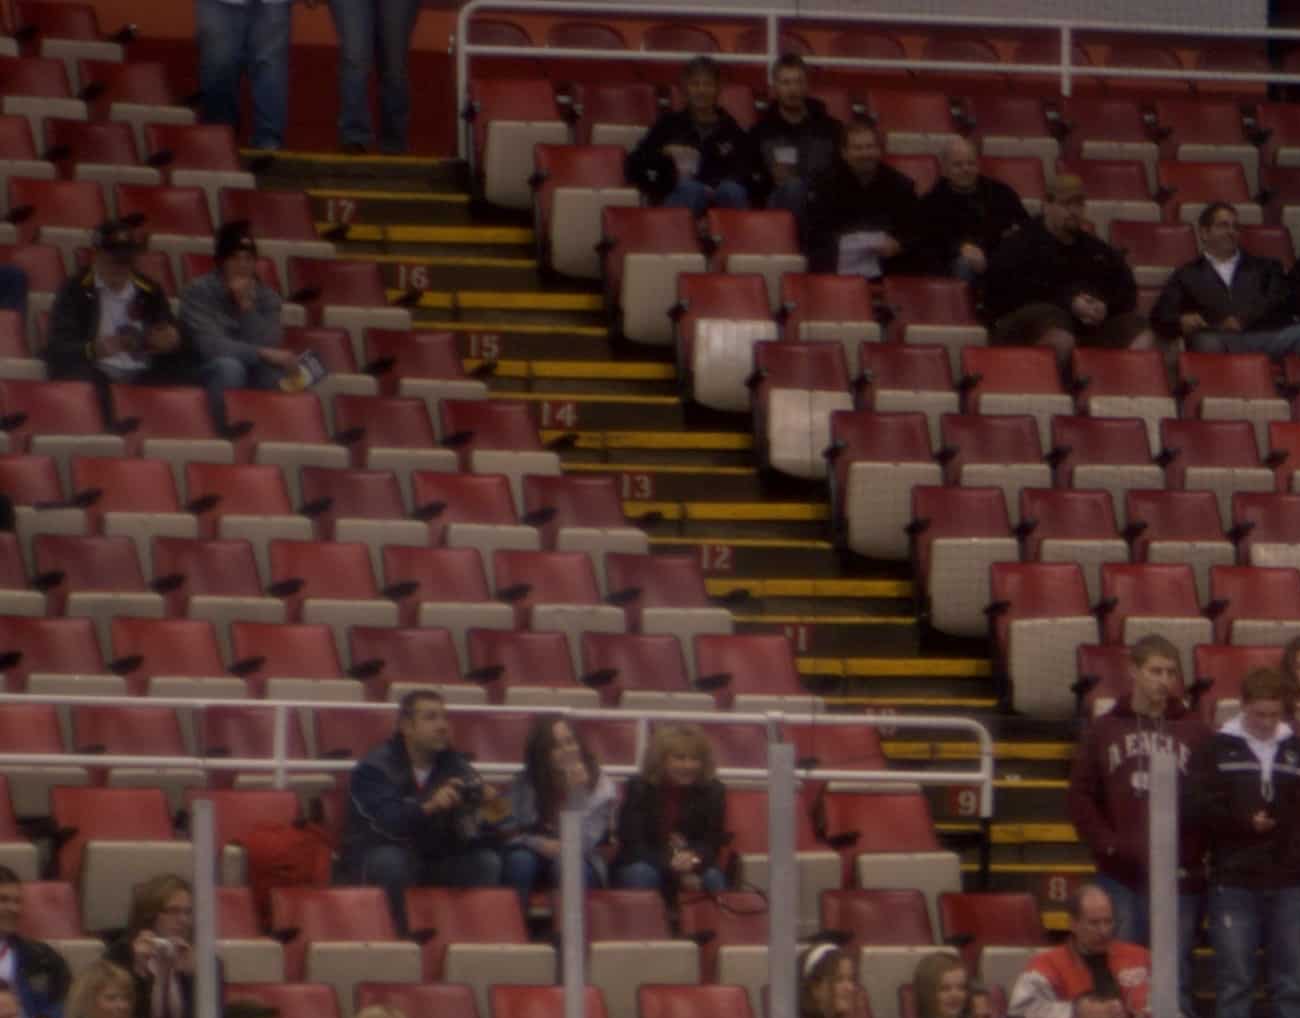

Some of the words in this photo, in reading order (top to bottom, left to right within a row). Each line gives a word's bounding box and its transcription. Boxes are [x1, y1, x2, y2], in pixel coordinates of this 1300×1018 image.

[326, 200, 354, 223] 17
[398, 265, 428, 288] 16
[469, 334, 499, 357] 15
[542, 402, 577, 427] 14
[622, 475, 651, 498] 13
[702, 546, 731, 570] 12
[958, 791, 977, 814] 9
[1049, 878, 1068, 898] 8
